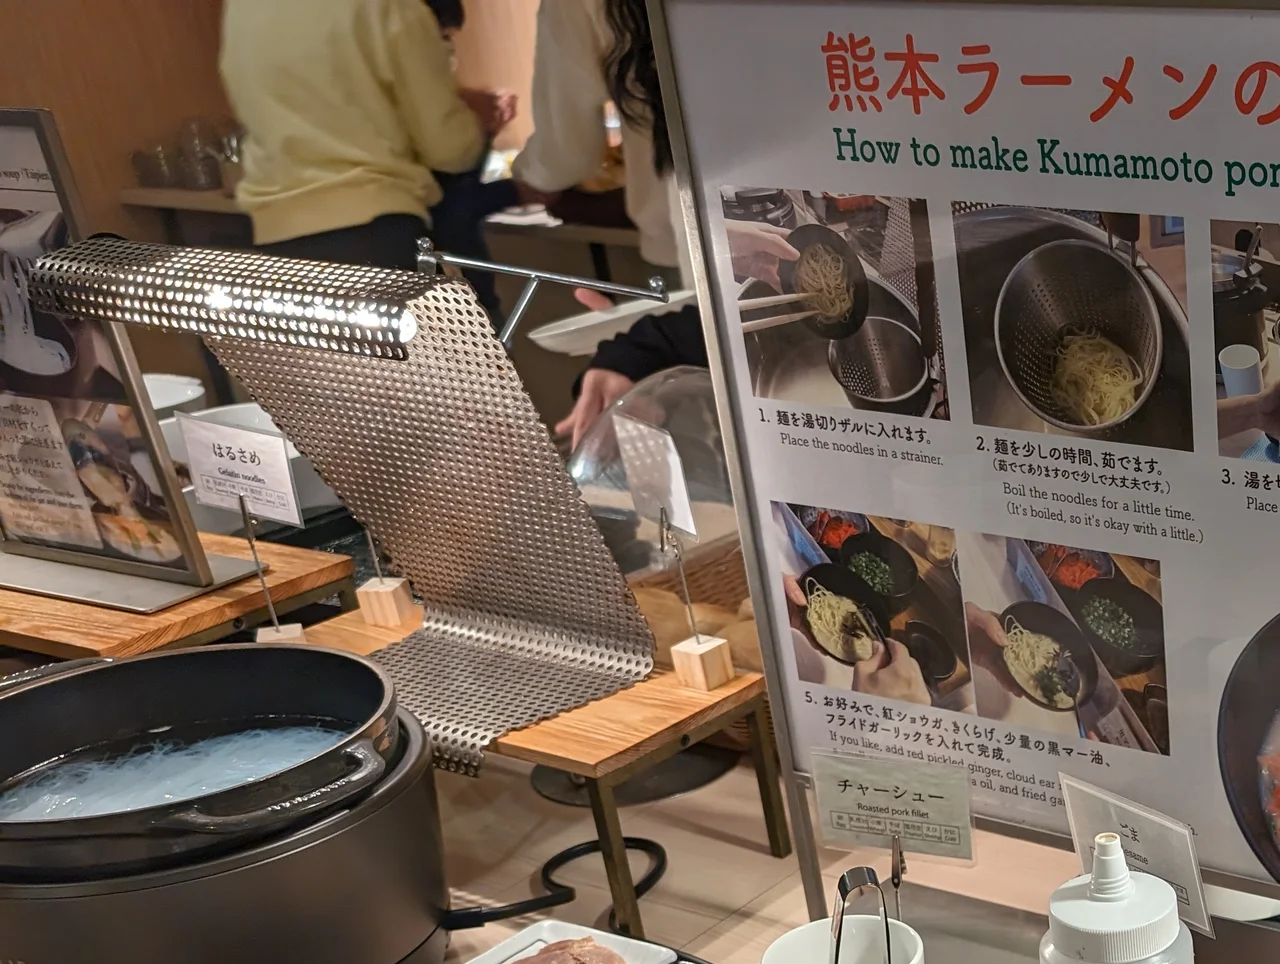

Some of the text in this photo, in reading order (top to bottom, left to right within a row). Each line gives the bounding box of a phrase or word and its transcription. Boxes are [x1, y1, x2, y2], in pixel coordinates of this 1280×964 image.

[833, 128, 901, 164] How
[911, 137, 940, 167] to
[950, 136, 1029, 172] make
[1037, 138, 1213, 184] Kumamoto
[776, 409, 932, 445] 麺を湯切りザルに入れます。
[211, 442, 262, 467] はるさめ
[780, 433, 944, 466] Place the noodles in a strainer.
[994, 437, 1163, 476] 麺を少しの時間、茹でます。
[1003, 482, 1195, 522] Boil the noodles for a little time.
[1246, 496, 1279, 513] Place
[1006, 501, 1204, 545] (It's boiled, so it's okay with a little.)
[825, 713, 1012, 764] フライドガーリックを入れて完成。
[829, 730, 838, 741] If
[841, 734, 859, 747] you
[861, 736, 883, 752] like,
[885, 744, 905, 756] add
[906, 749, 925, 761] red
[967, 760, 1004, 780] ginger,
[1006, 767, 1036, 786] cloud
[1039, 776, 1056, 789] ear
[837, 779, 945, 803] チャーシュー
[980, 778, 997, 793] oil,
[999, 783, 1019, 796] and
[1021, 787, 1047, 803] fried
[857, 802, 930, 819] Roasted pork fillet
[1124, 848, 1149, 865] esame
